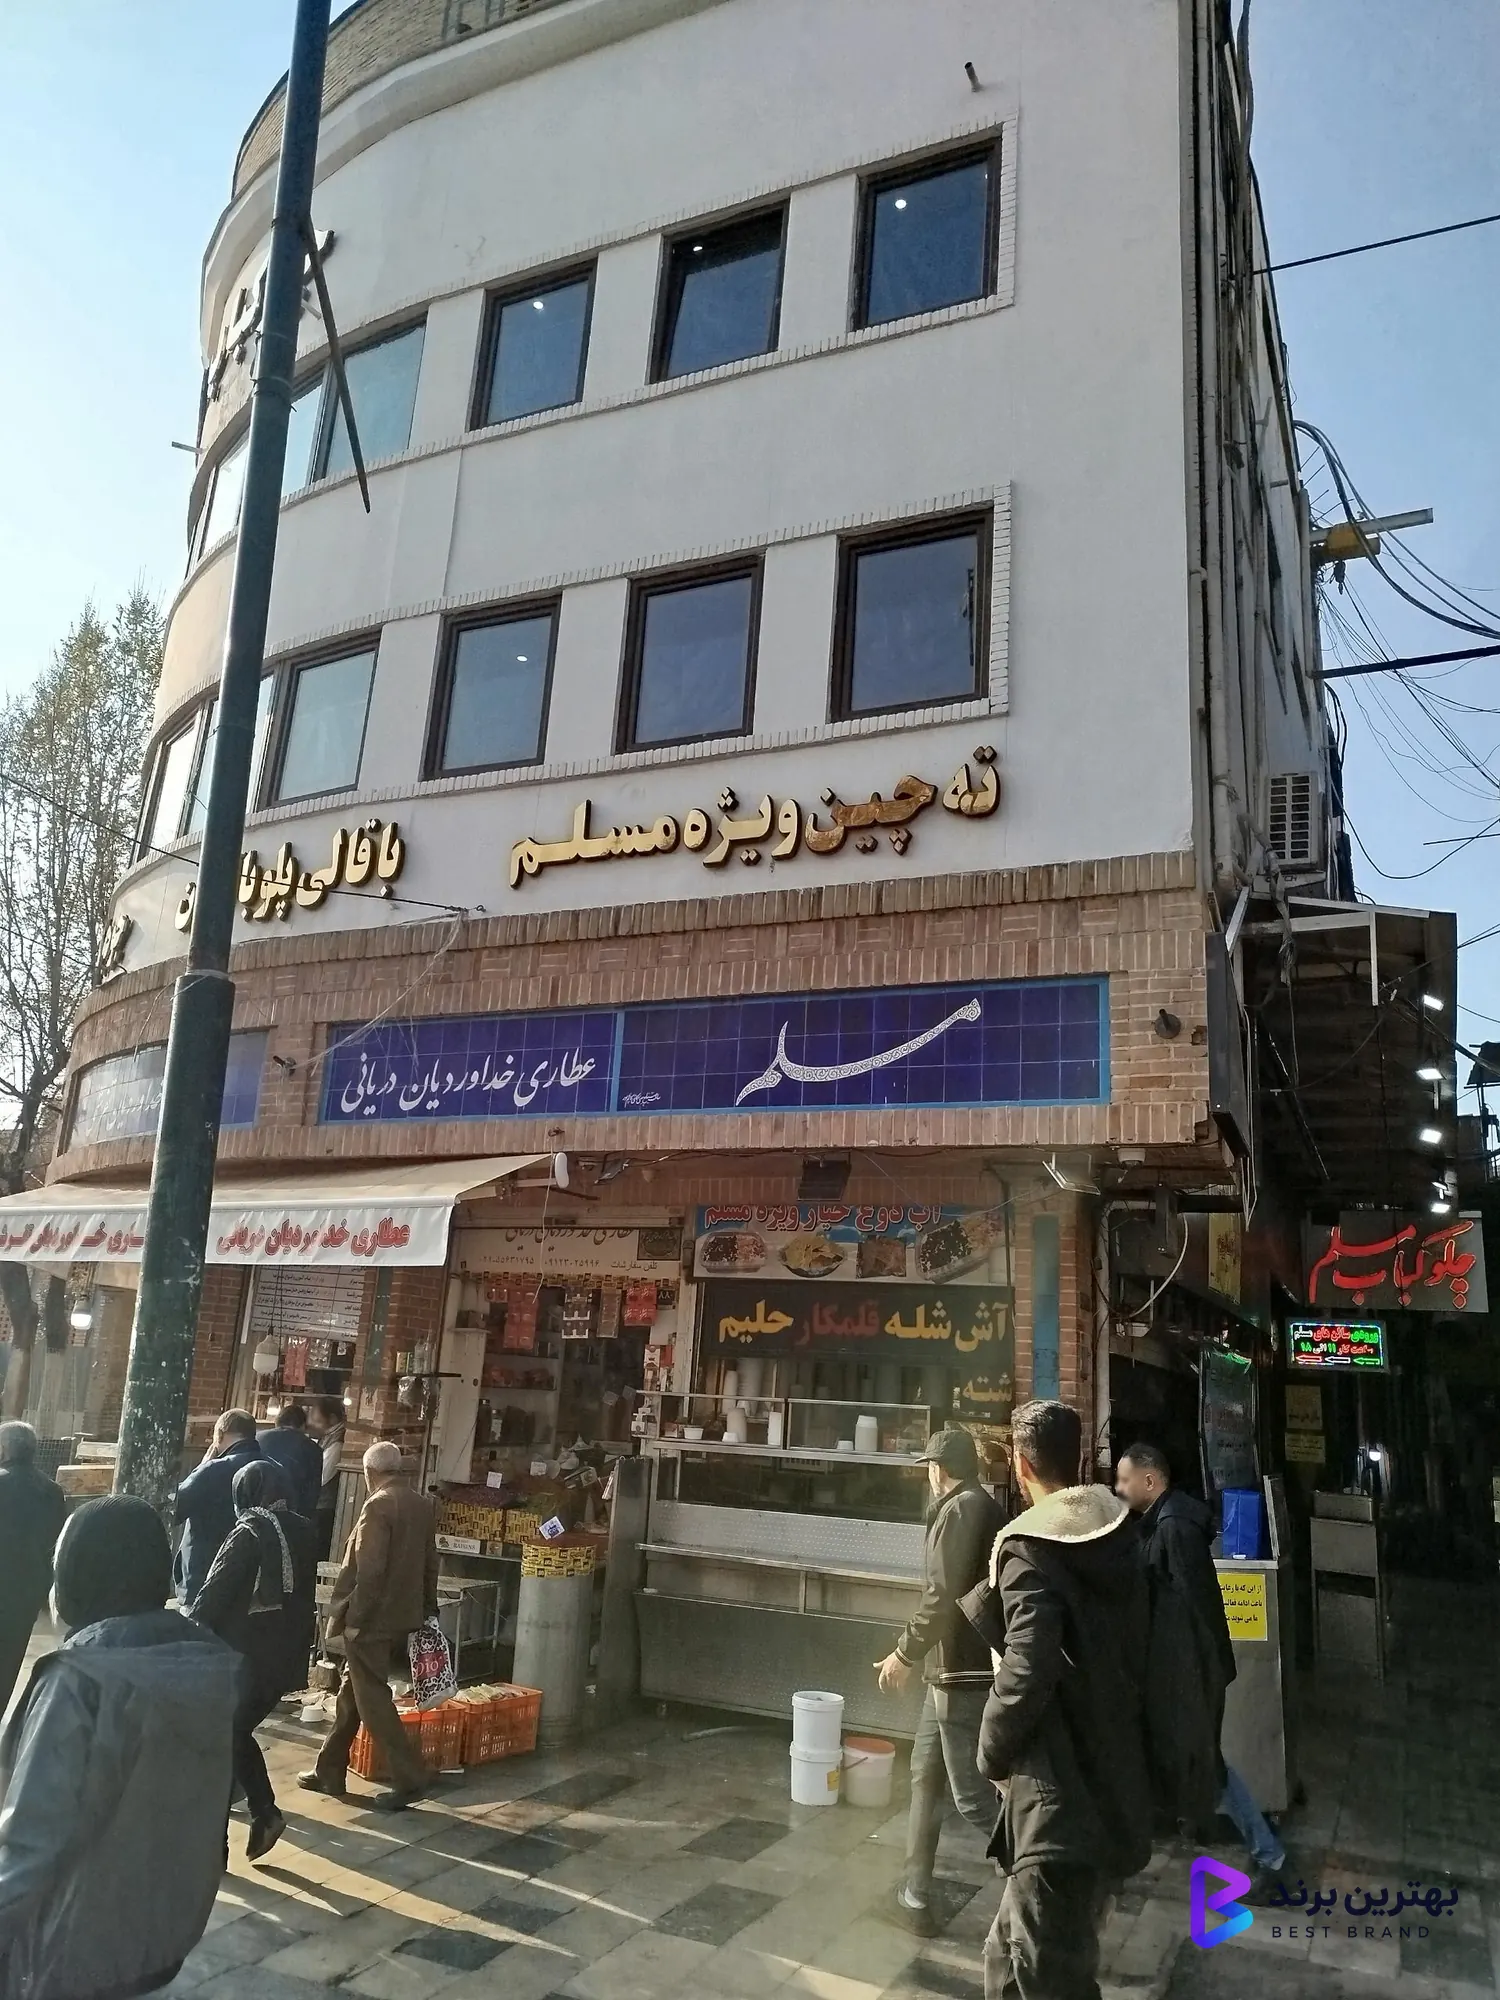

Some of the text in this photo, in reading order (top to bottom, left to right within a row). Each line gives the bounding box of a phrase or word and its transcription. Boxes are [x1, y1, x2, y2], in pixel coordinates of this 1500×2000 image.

[508, 798, 681, 890] مسلم
[682, 785, 803, 868] ویژه
[251, 841, 299, 922] پلو
[340, 1052, 397, 1116] دریانی
[513, 1047, 596, 1107] عطاری
[735, 997, 982, 1107] مسلم
[351, 1217, 411, 1257] عطاری
[1308, 1222, 1418, 1304] مسلم
[718, 1299, 1009, 1353] آش شله قلمکار حلیم
